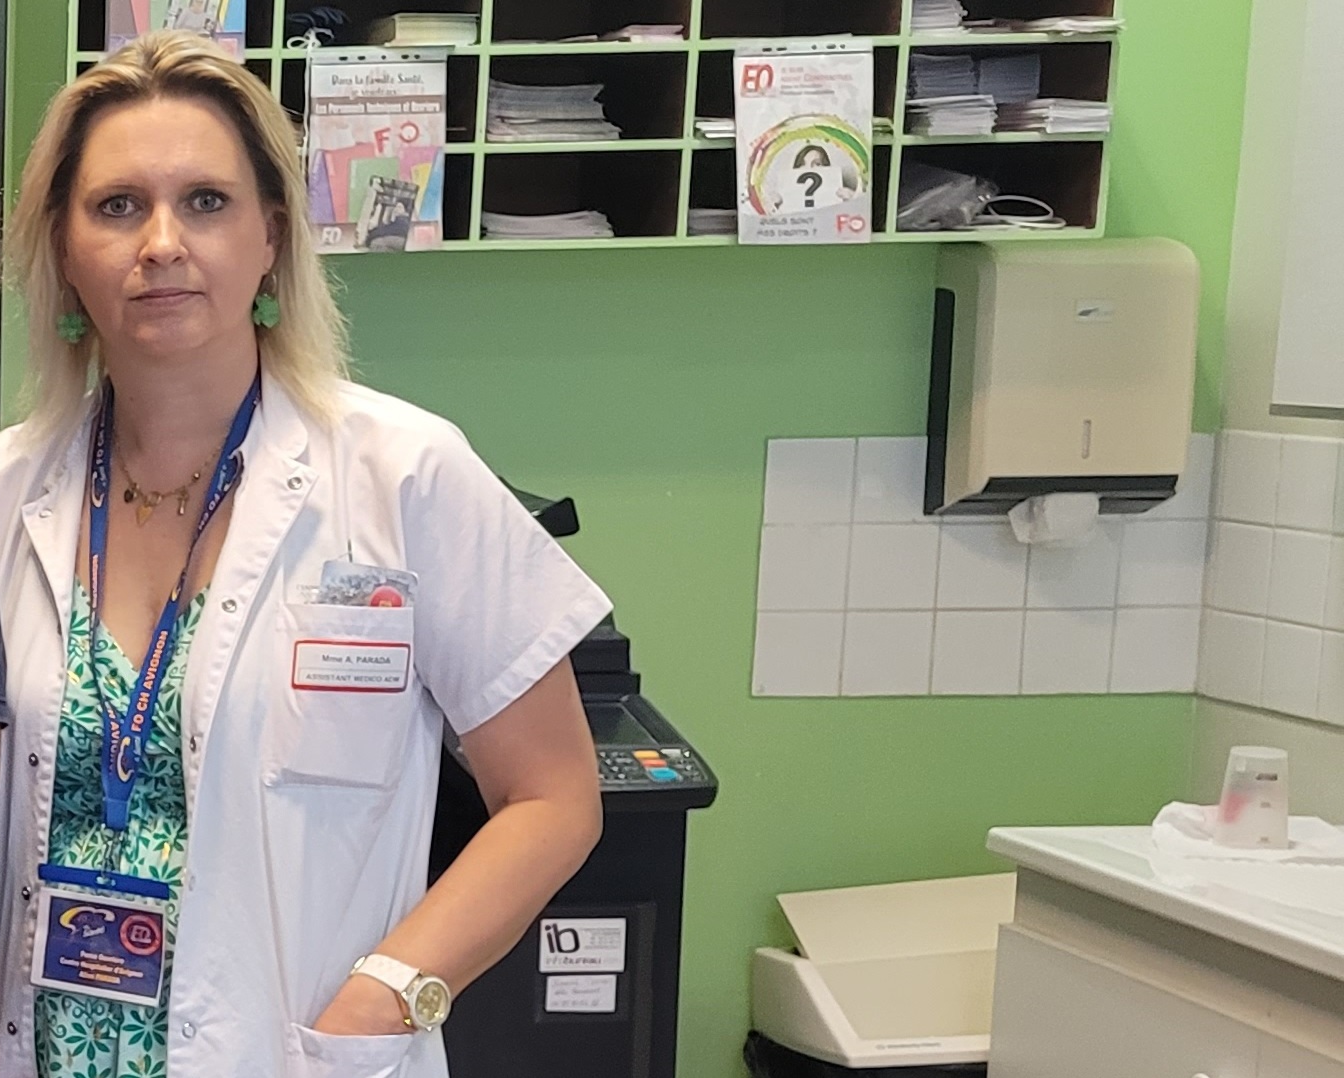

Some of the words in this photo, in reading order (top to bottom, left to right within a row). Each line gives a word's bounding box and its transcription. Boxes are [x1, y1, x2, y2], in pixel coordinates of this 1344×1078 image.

[143, 630, 169, 690] AVIGNON
[136, 691, 151, 712] CH
[131, 713, 145, 732] FO
[544, 923, 580, 954] ib
